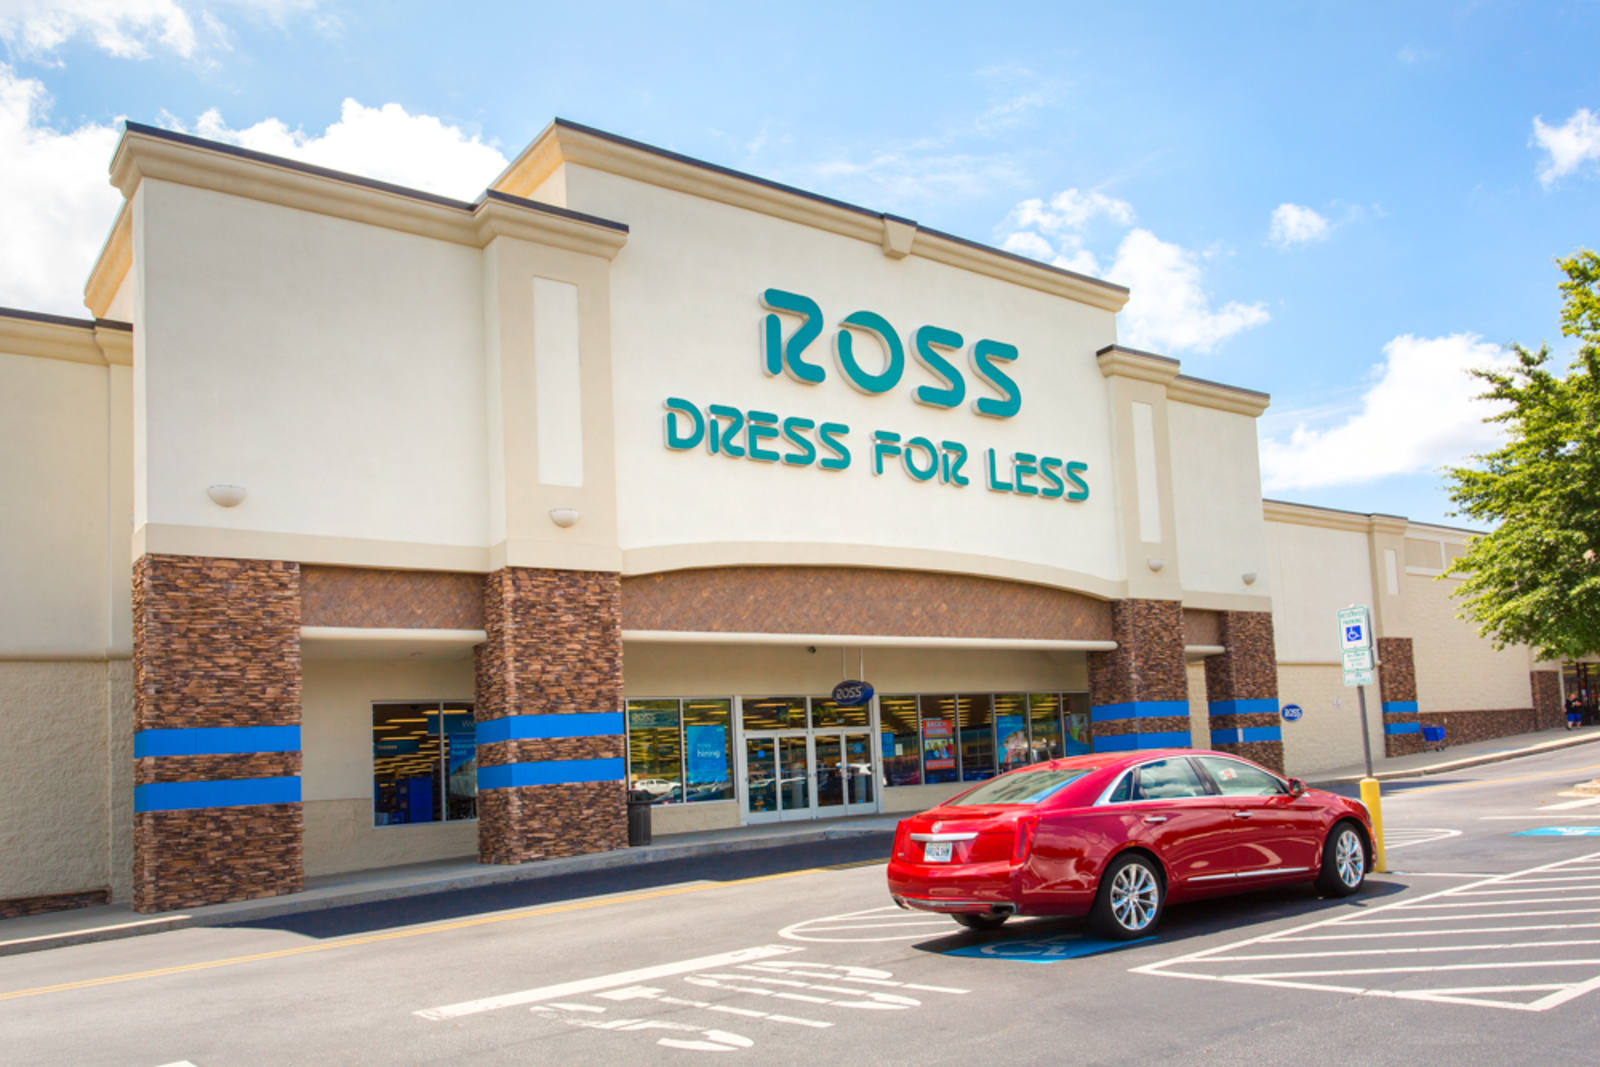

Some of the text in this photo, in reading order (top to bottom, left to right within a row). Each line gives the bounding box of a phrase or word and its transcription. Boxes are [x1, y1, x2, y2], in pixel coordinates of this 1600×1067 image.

[760, 287, 1021, 418] ROSS
[665, 396, 1089, 501] DRESS FOR LESS
[836, 685, 862, 700] ROSS
[530, 960, 972, 1052] STOP
